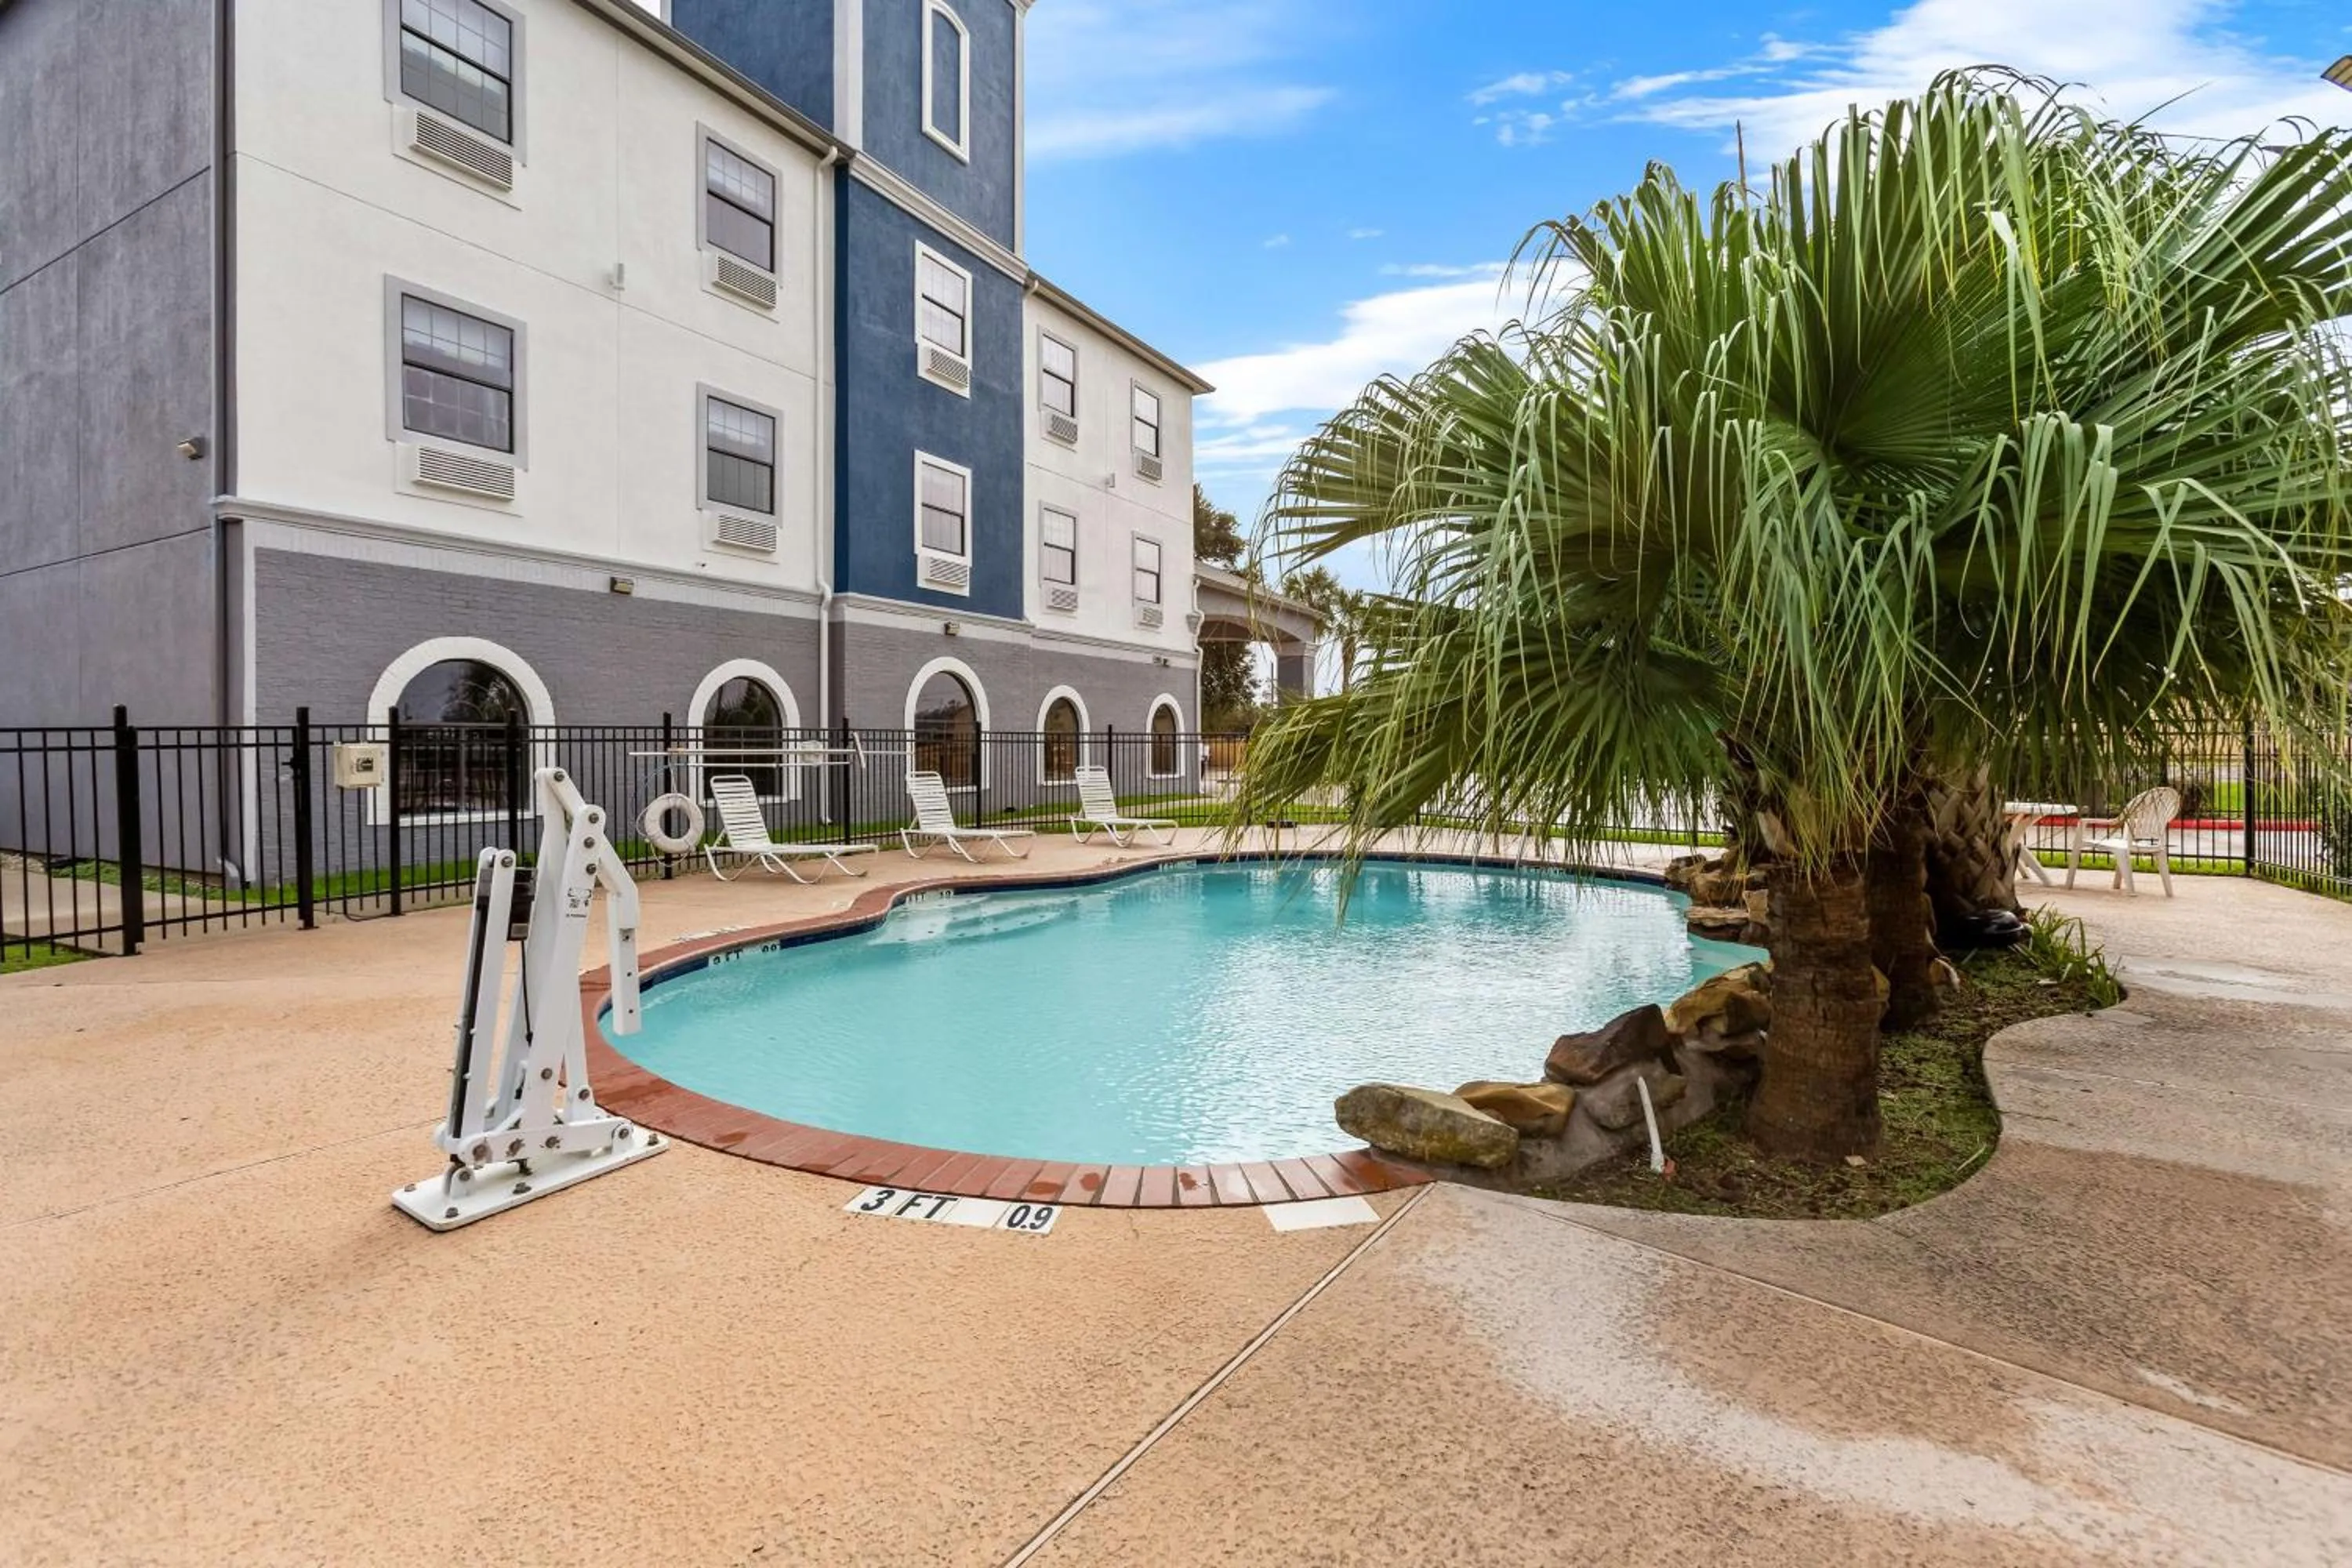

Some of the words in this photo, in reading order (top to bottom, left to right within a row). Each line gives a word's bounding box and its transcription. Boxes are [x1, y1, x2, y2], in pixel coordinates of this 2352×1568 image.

[860, 1189, 895, 1210] 3
[895, 1194, 958, 1218] FT
[1007, 1205, 1053, 1229] 0.9
